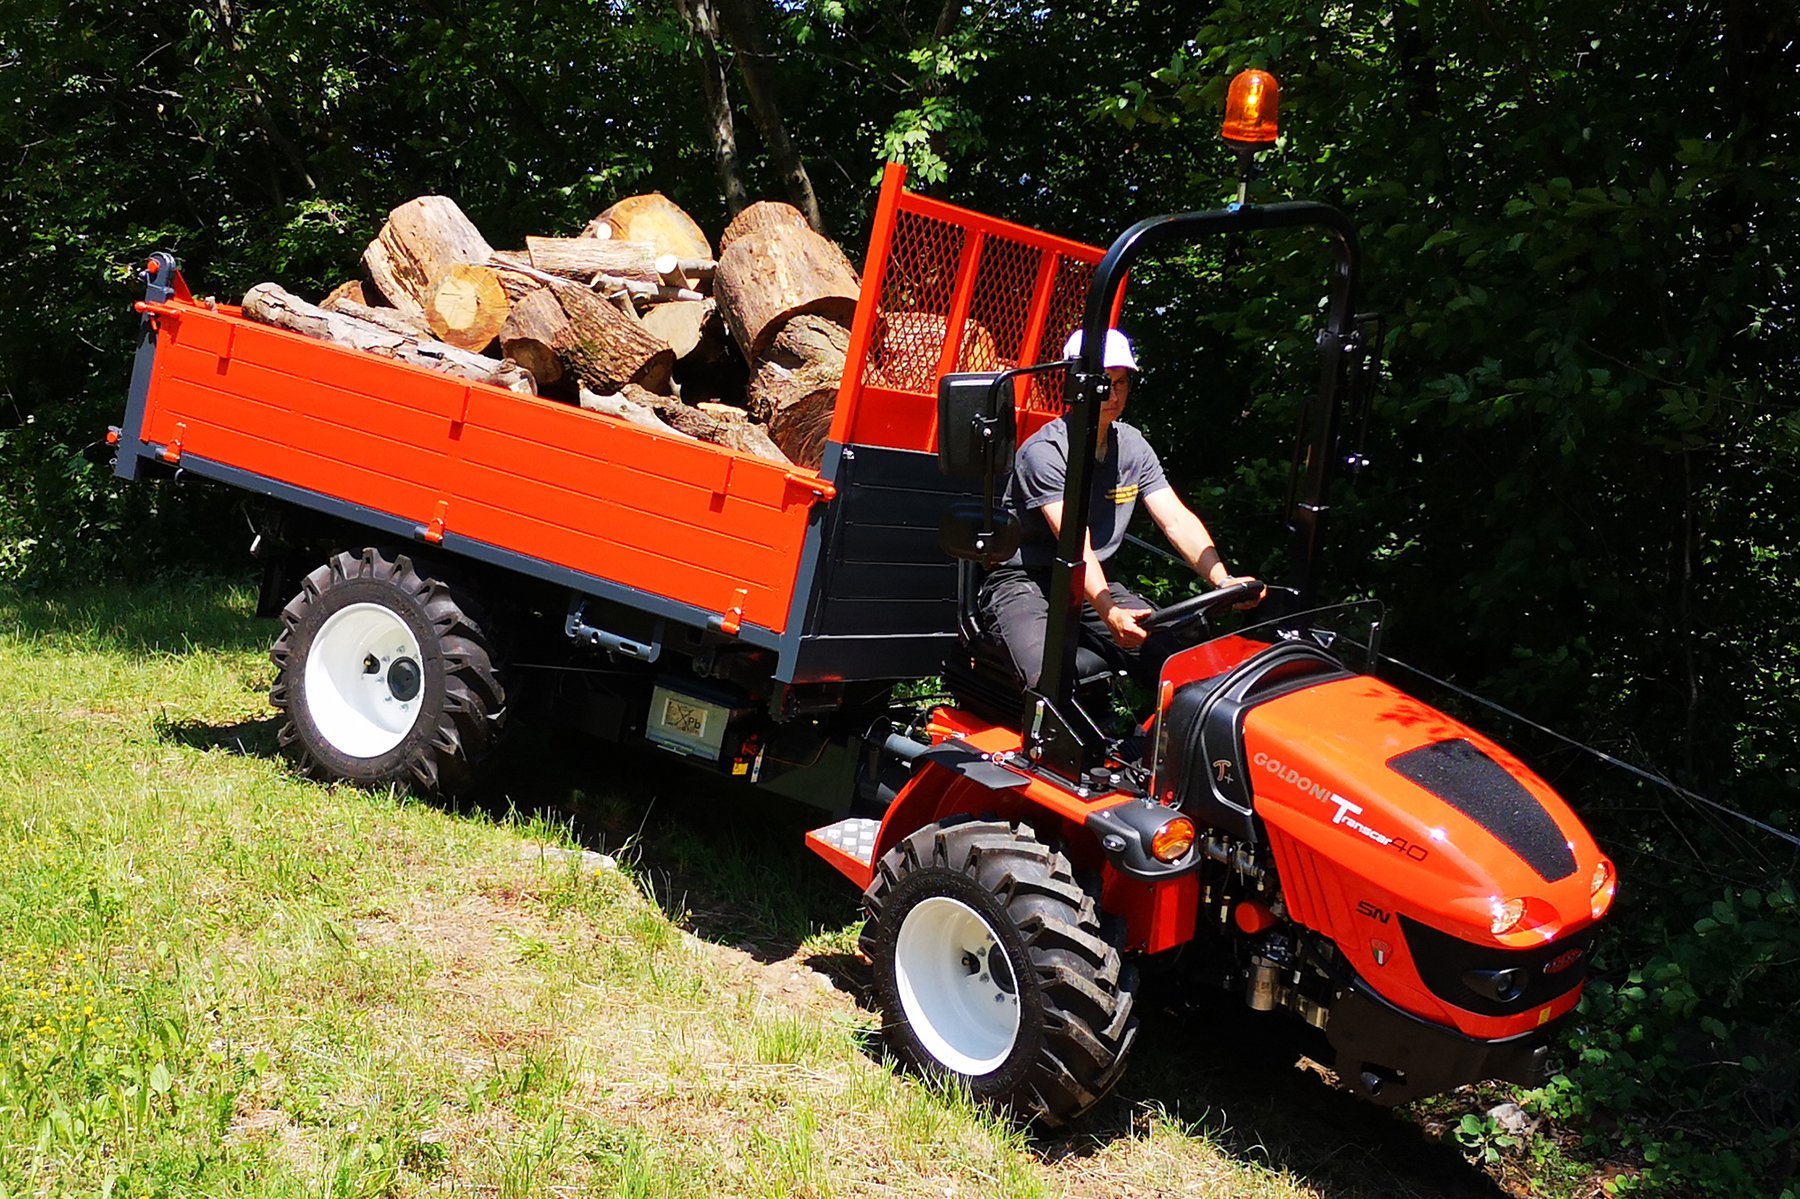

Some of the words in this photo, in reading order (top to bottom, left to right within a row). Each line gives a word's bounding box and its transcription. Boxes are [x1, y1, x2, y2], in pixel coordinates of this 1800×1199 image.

[688, 717, 701, 729] Pb
[1253, 752, 1331, 803] GOLDONI
[1330, 793, 1393, 845] Transcar
[1390, 837, 1428, 861] 40
[1356, 900, 1390, 924] SN
